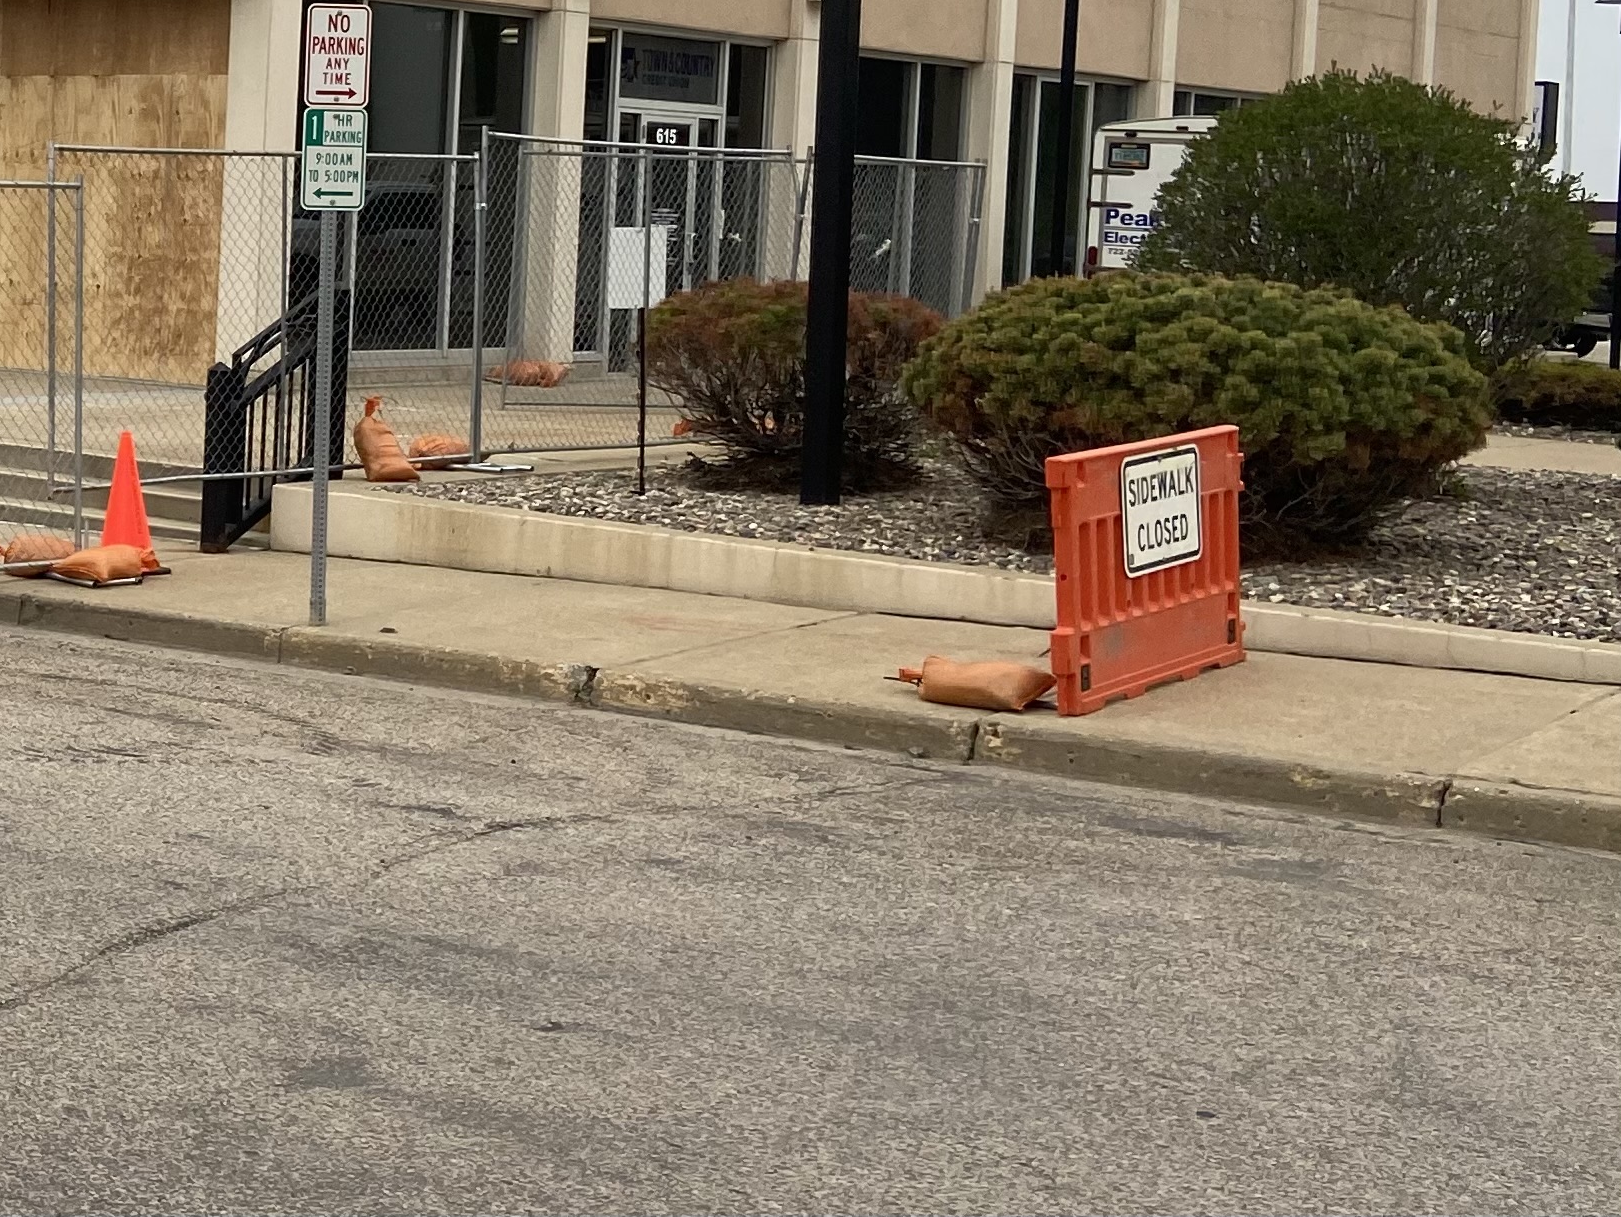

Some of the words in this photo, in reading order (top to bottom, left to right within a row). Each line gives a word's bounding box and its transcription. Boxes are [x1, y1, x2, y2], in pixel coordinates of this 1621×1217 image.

[328, 14, 351, 33] NO
[312, 36, 364, 56] PARKING
[326, 57, 350, 71] ANY
[323, 72, 351, 85] TIME
[311, 115, 318, 140] 1
[337, 114, 353, 127] HR
[323, 130, 362, 144] PARKING
[656, 128, 677, 144] 615
[309, 169, 319, 182] TO
[1129, 465, 1194, 507] SIDEWALK
[1137, 513, 1189, 552] CLOSED
